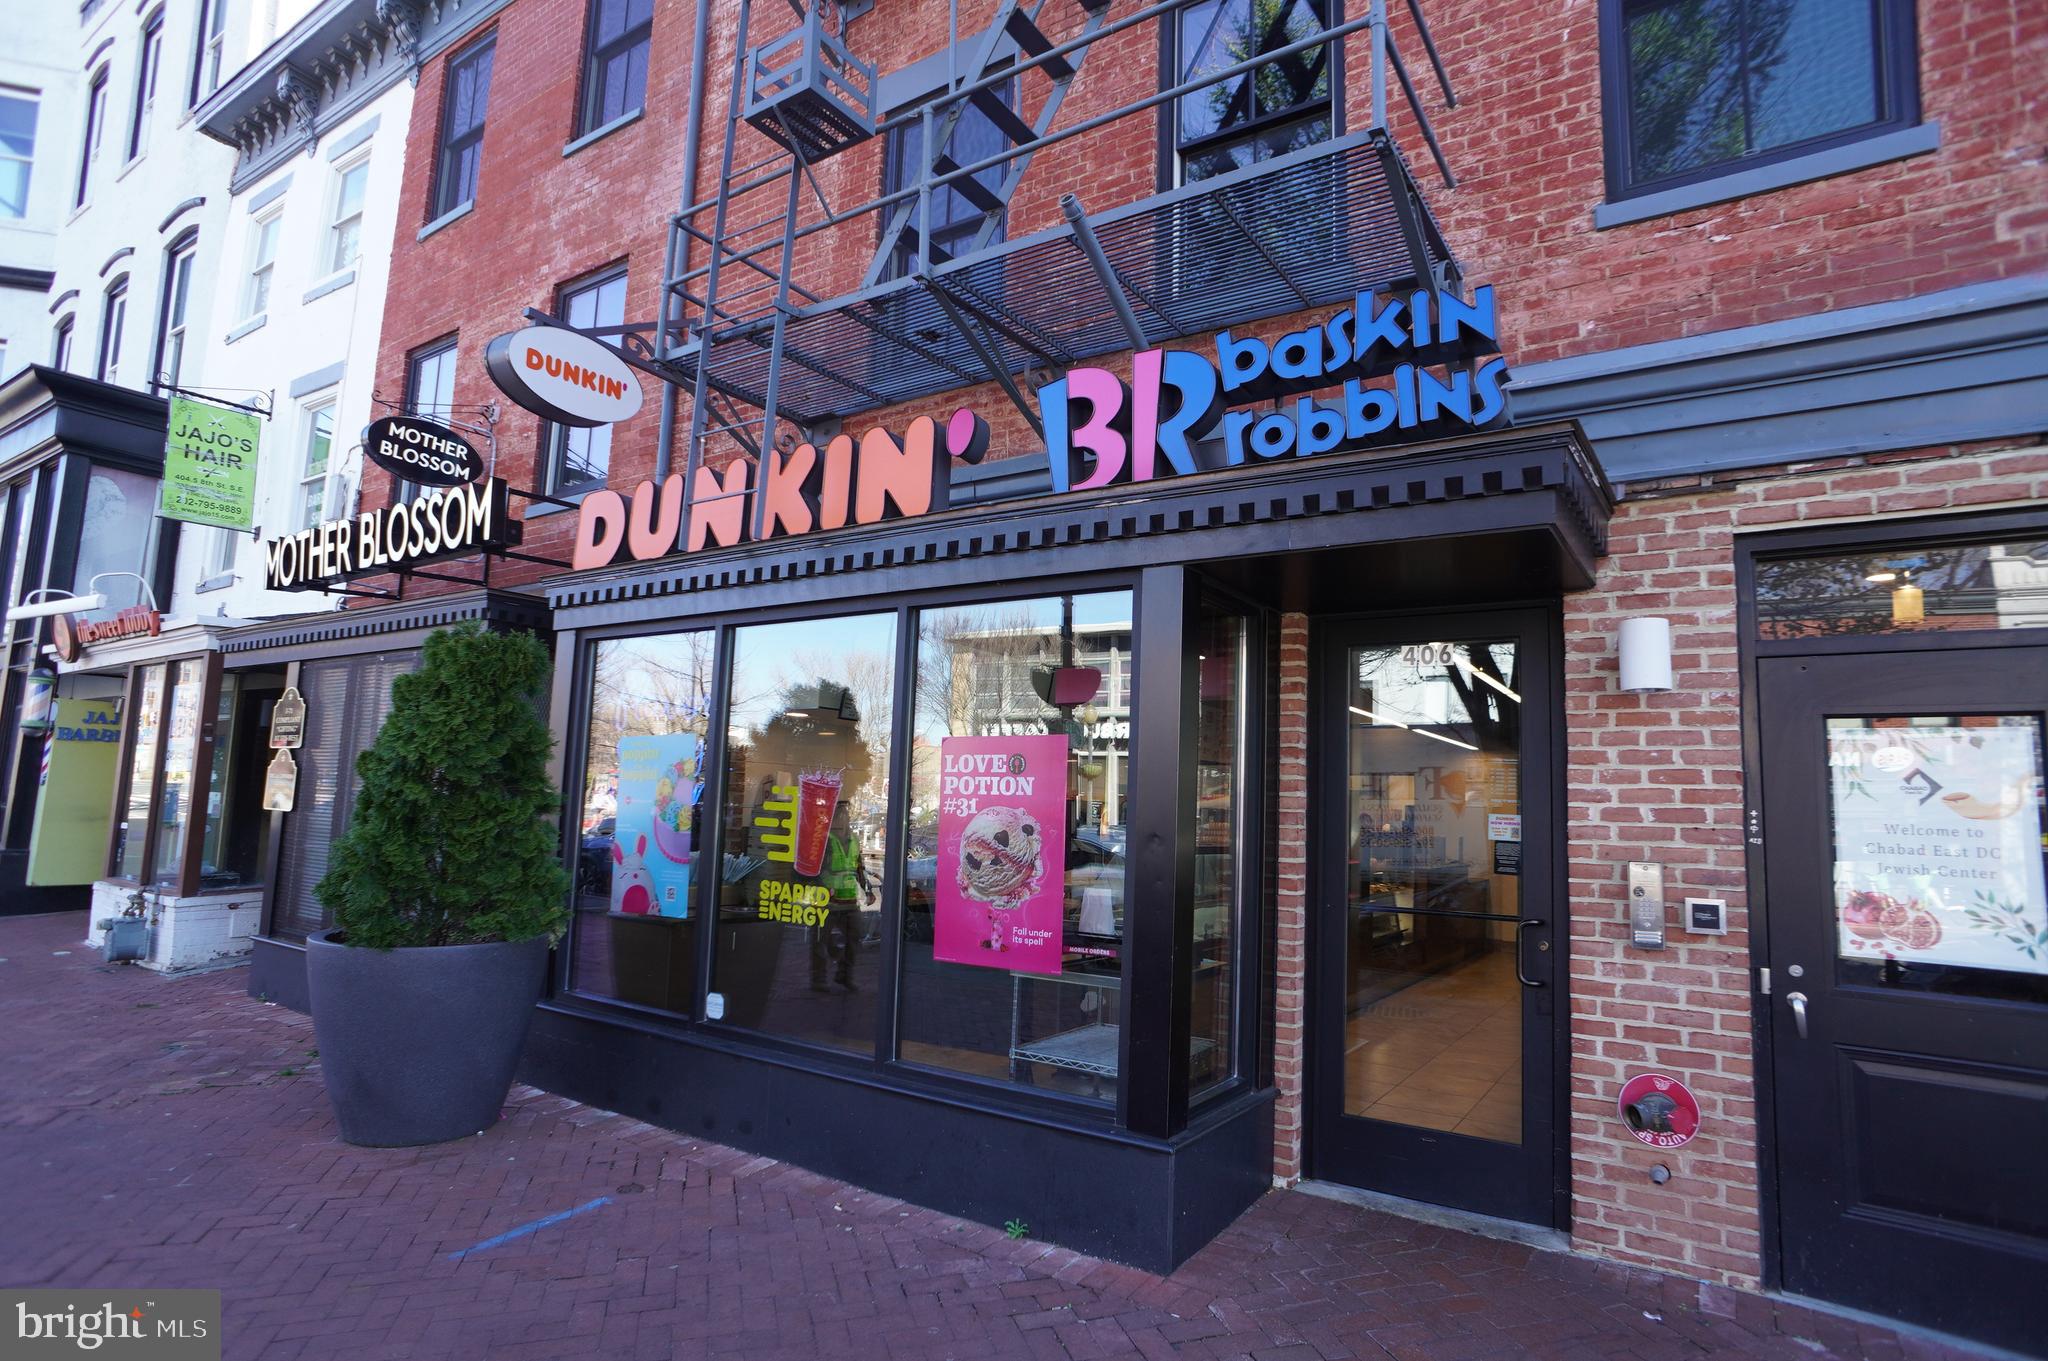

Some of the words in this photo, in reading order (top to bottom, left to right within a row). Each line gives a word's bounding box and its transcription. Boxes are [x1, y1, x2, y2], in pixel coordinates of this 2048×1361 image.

[524, 346, 629, 401] DUNKIN'
[175, 424, 253, 452] JAJO'S
[388, 421, 468, 461] MOTHER
[183, 443, 242, 470] HAIR
[379, 439, 471, 481] BLOSSOM
[571, 407, 988, 571] DUNKIN'
[264, 518, 352, 588] MOTHER
[358, 476, 494, 569] BLOSSOM
[1402, 645, 1452, 666] 406
[944, 754, 1008, 773] LOVE
[943, 776, 1036, 796] POTION
[943, 797, 979, 817] #31
[1883, 823, 1960, 838] Welcome
[1967, 826, 1984, 838] to
[1865, 842, 1927, 856] Chabad
[1933, 845, 1969, 859] East
[1976, 847, 2002, 859] DC
[1877, 862, 1931, 876] Jewish
[1937, 865, 2000, 880] Center
[758, 900, 830, 928] ENERGY
[1012, 926, 1028, 936] Fall
[1028, 929, 1053, 938] under
[1012, 936, 1023, 944] its
[1024, 937, 1044, 946] spell
[1635, 1129, 1655, 1142] SP
